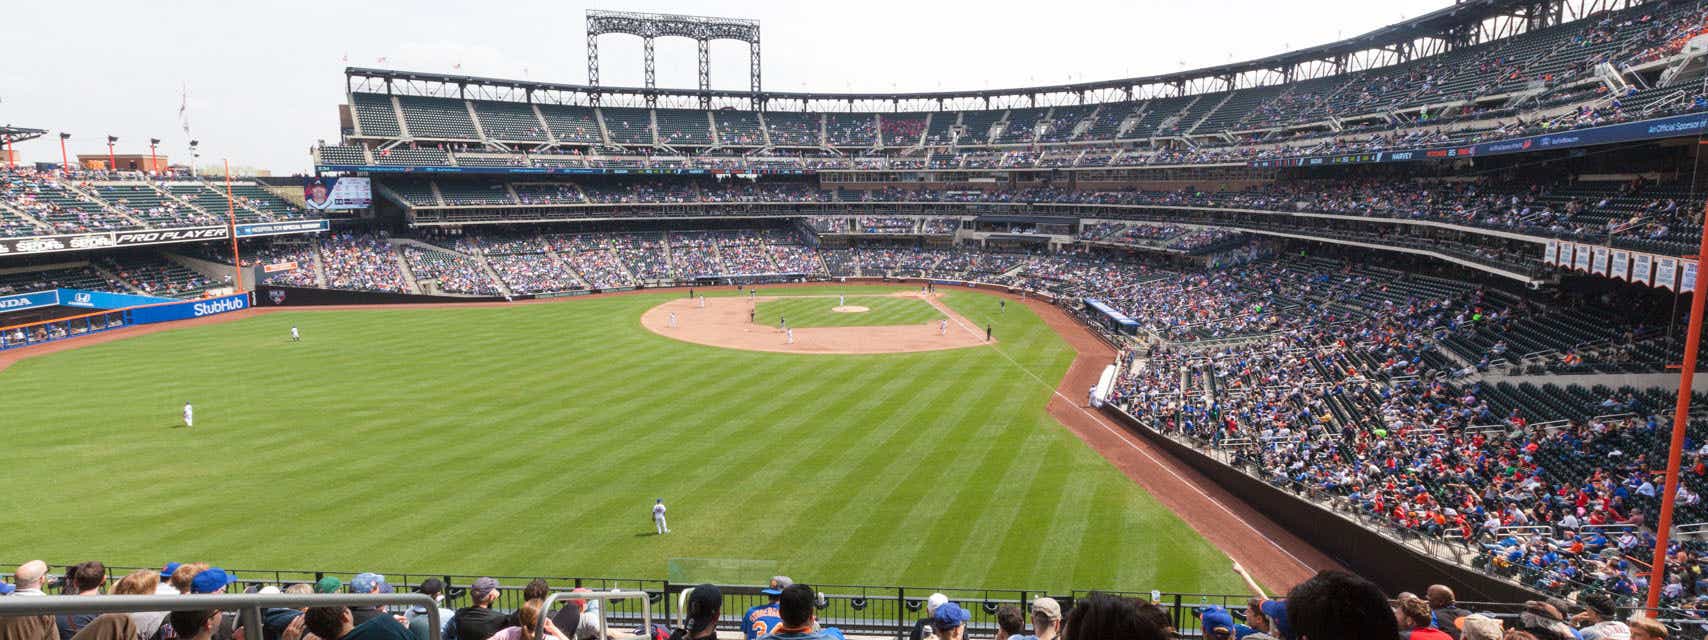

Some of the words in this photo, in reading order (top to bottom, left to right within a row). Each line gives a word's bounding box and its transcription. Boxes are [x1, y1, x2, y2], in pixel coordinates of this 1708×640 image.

[1656, 123, 1675, 132] Official
[1676, 121, 1699, 131] Sponsor
[1392, 151, 1413, 160] HARVEY
[117, 233, 159, 243] PRO
[160, 229, 227, 240] PLAYER
[194, 298, 243, 316] StubHub
